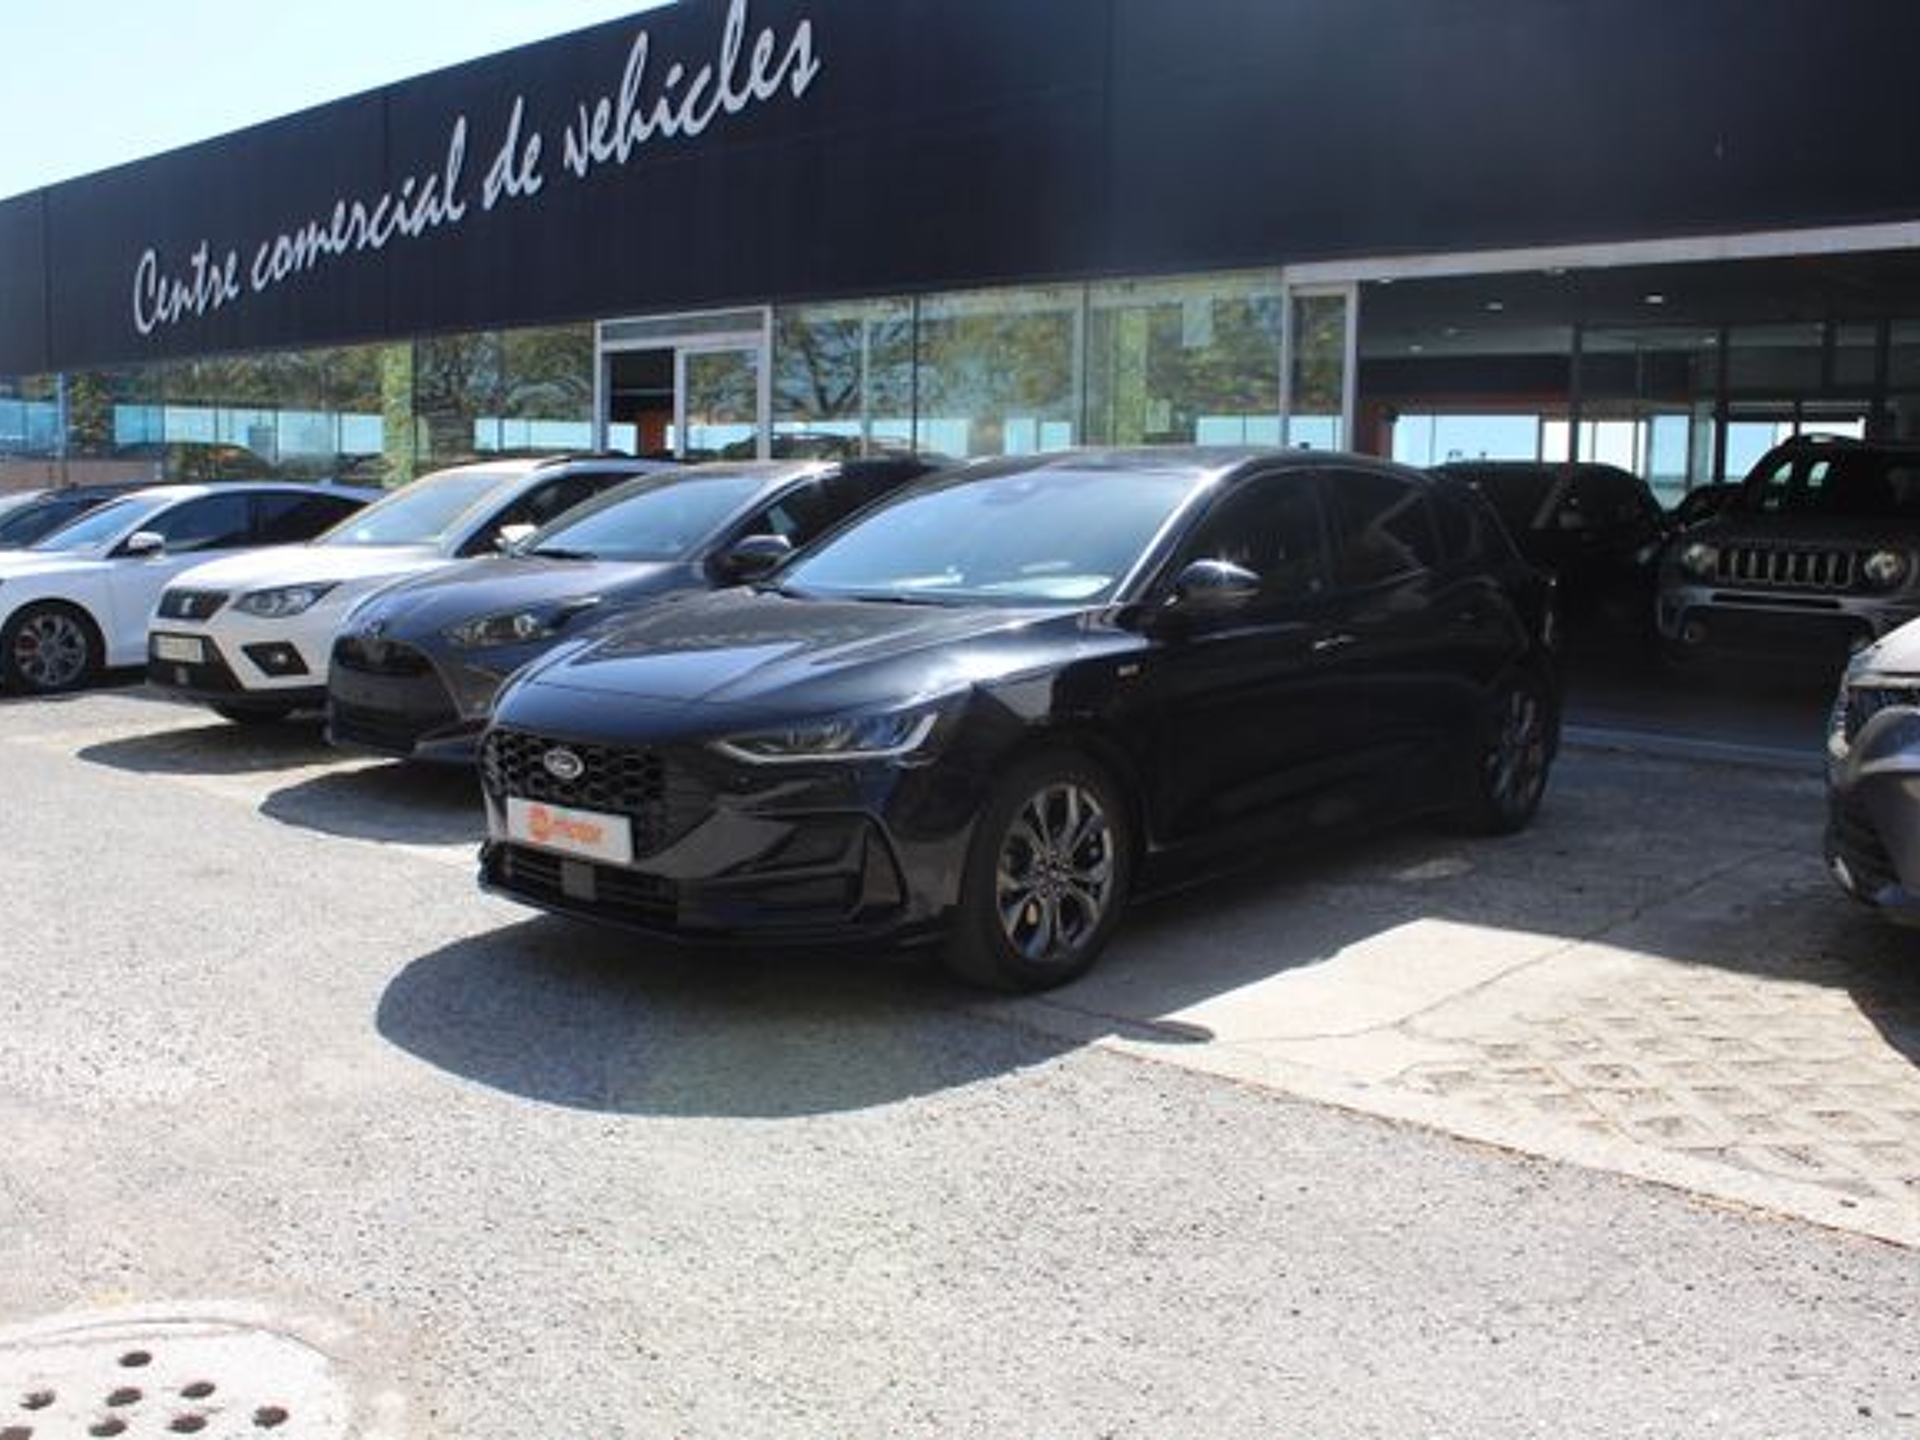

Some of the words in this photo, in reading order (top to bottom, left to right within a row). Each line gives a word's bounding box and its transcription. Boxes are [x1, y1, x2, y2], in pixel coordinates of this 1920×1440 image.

[133, 240, 240, 335] Centre
[250, 115, 466, 291] comercial
[482, 95, 543, 210] de
[563, 0, 820, 177] vehicles
